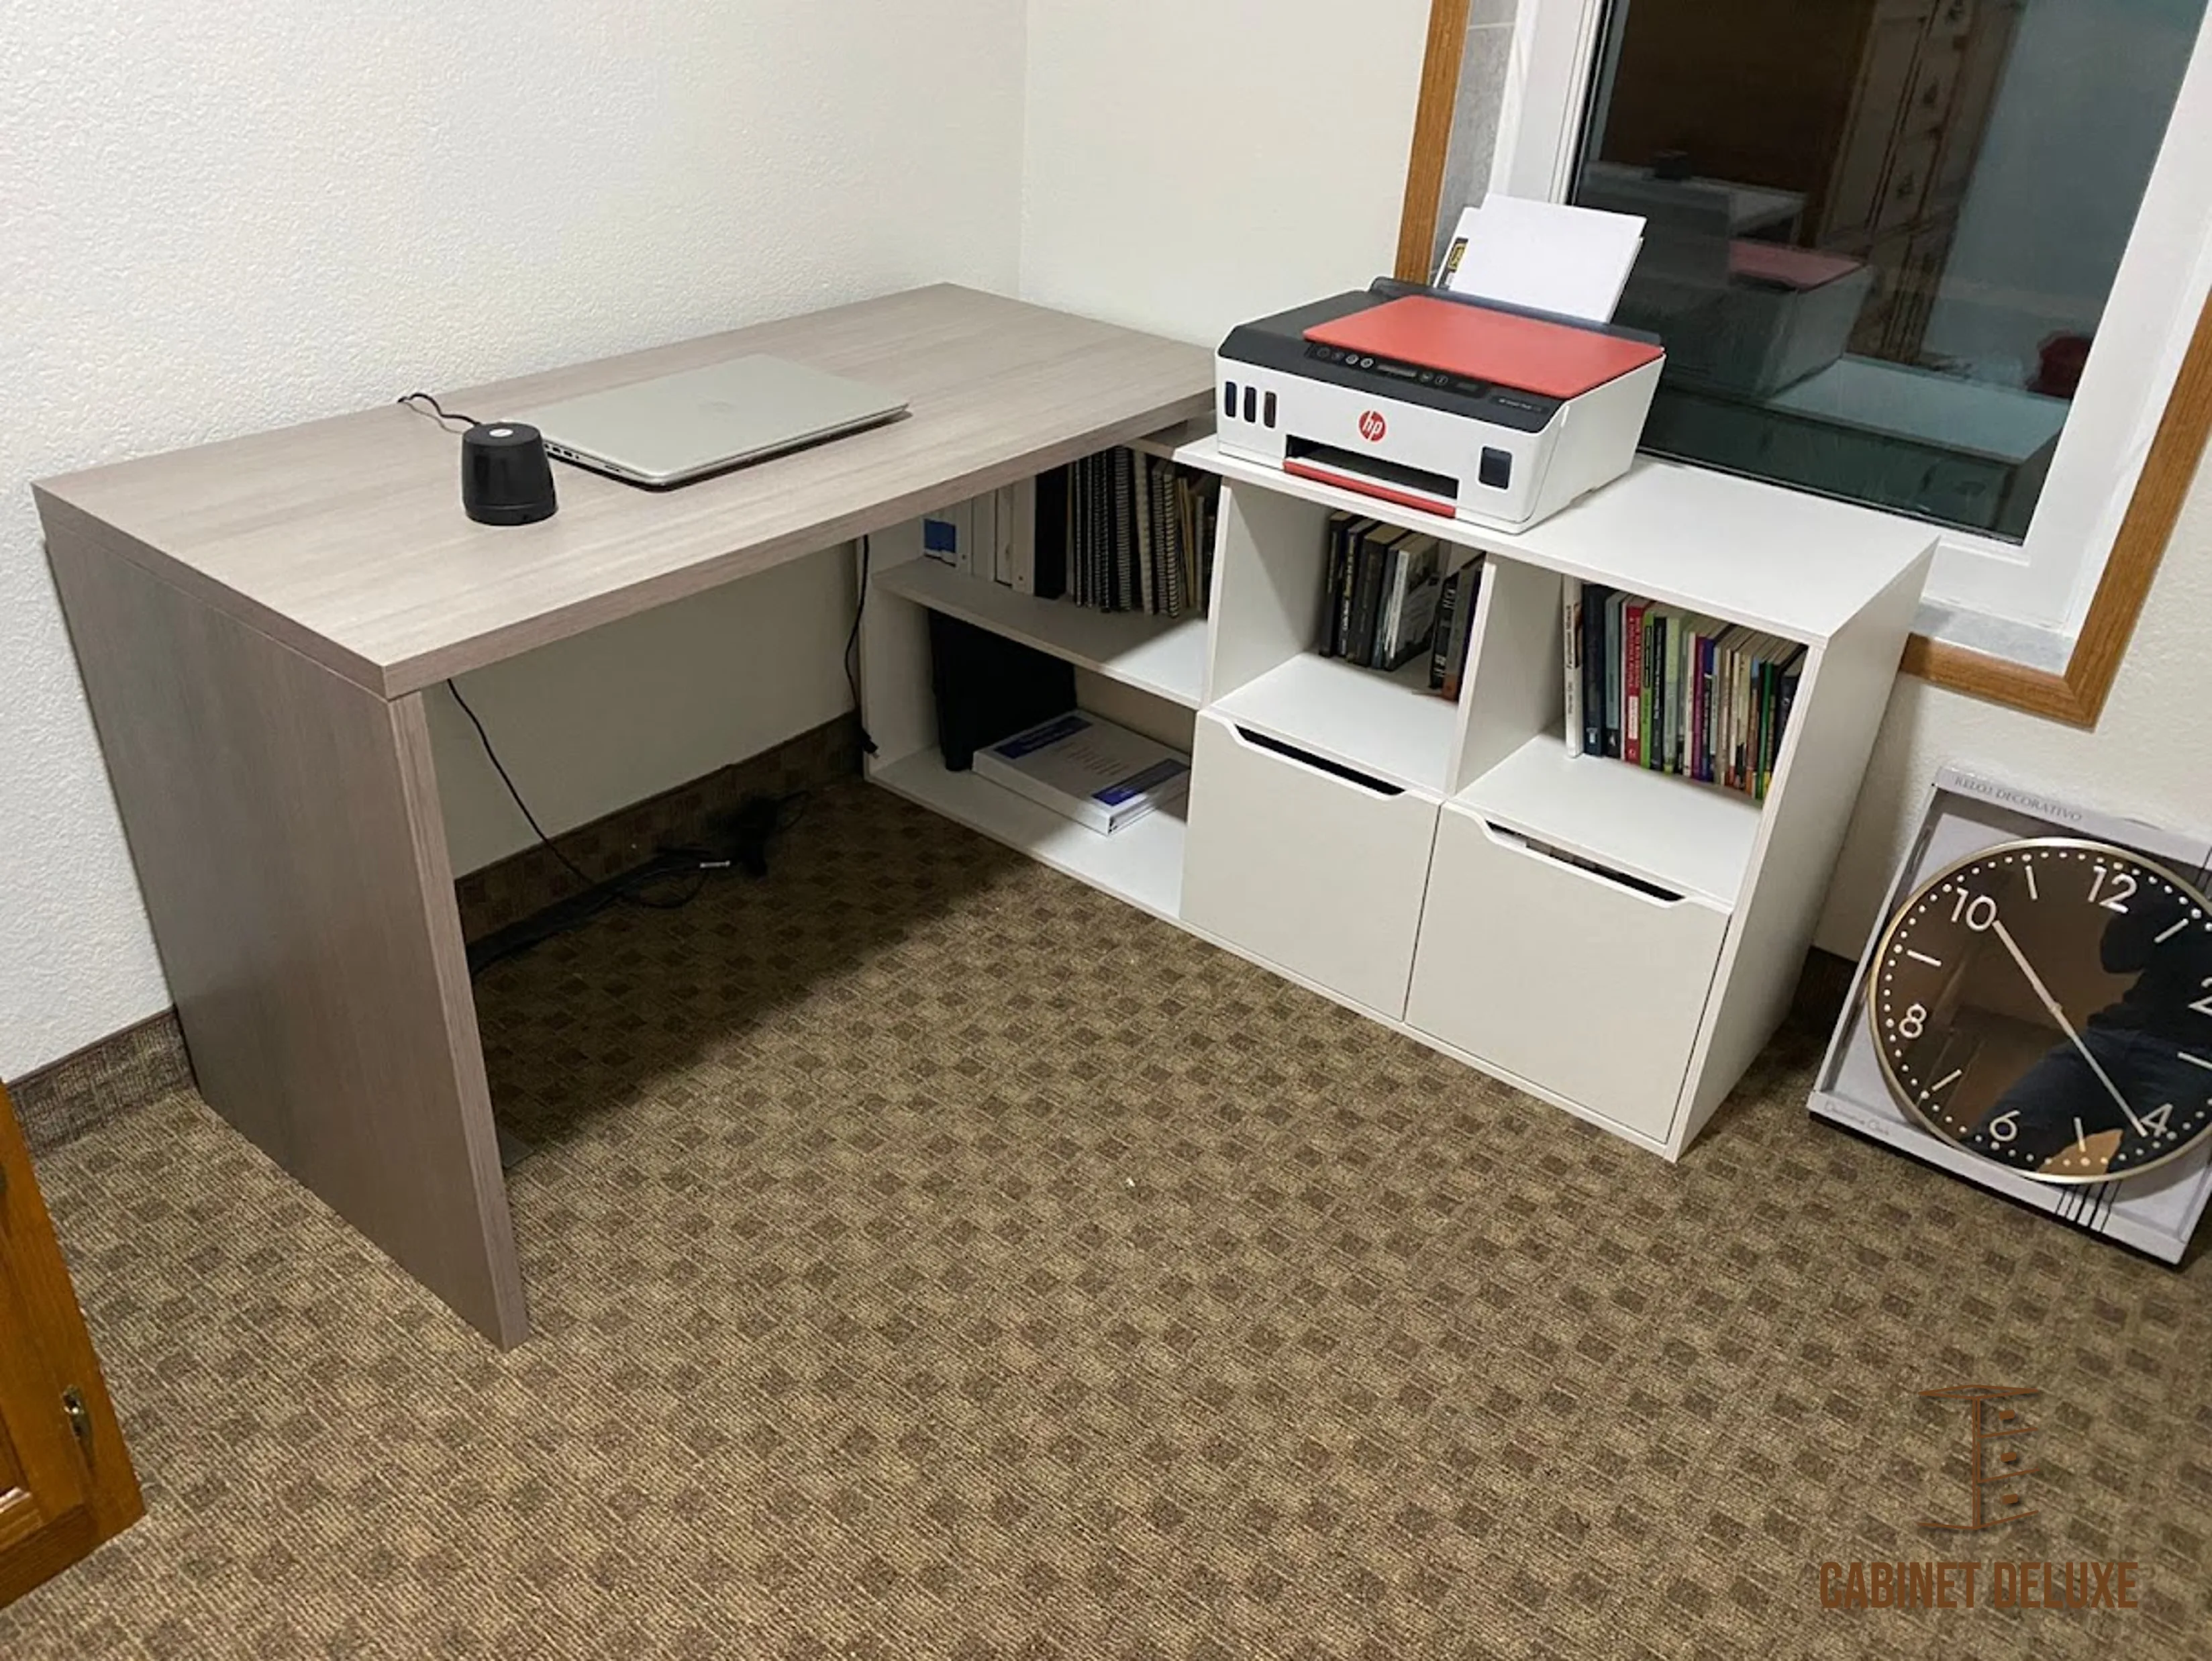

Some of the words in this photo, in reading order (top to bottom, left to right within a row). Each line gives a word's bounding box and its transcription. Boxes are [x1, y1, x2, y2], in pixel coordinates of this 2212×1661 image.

[1361, 409, 1385, 442] hp
[1954, 775, 1993, 796] RELOJ
[1995, 788, 2082, 822] DECORATIVO
[2087, 865, 2138, 914] 12
[1950, 887, 1998, 932] 10
[2187, 976, 2212, 1016] 2
[1899, 1003, 1927, 1039] 8
[1989, 1109, 2021, 1142] 6
[2140, 1103, 2174, 1137] 4
